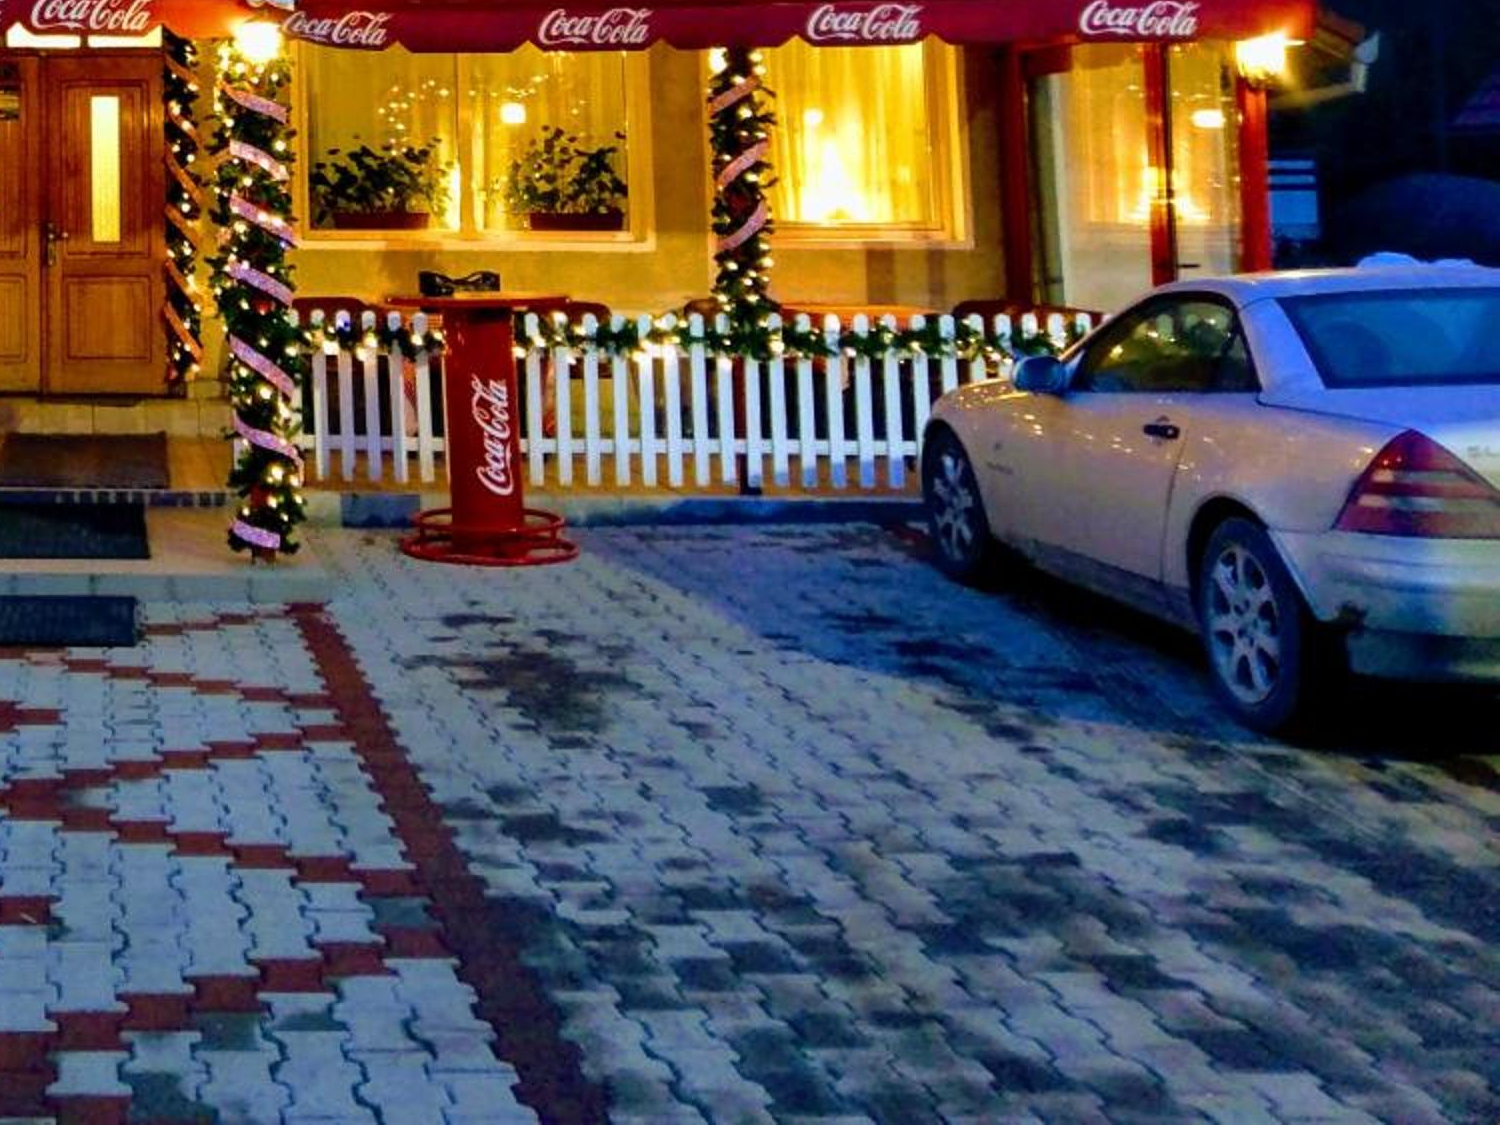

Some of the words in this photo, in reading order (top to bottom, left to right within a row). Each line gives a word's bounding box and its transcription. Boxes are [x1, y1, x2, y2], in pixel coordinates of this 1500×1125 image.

[281, 10, 395, 46] Coca-Cola
[538, 7, 654, 44] Coca-Cola
[806, 3, 925, 40] Coca-Cola
[1079, 0, 1201, 37] Coca-Cola
[470, 374, 514, 496] Coca-Cola
